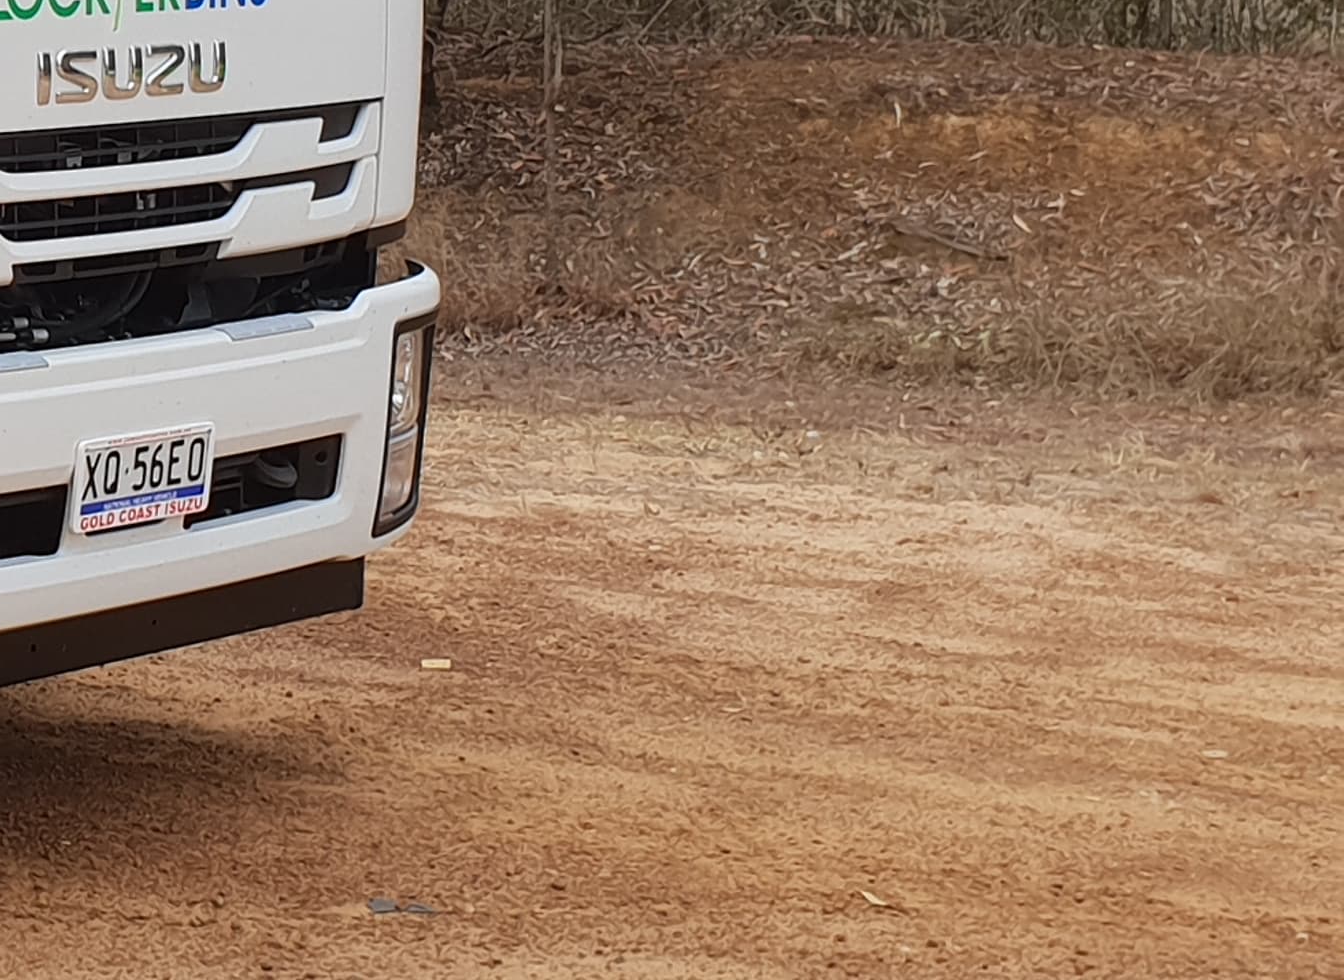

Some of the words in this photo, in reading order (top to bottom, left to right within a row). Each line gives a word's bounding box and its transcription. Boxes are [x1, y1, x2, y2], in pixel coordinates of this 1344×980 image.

[36, 40, 226, 106] ISUZU
[80, 512, 115, 531] GOLD
[119, 504, 160, 523] COAST
[164, 497, 203, 517] ISUZU
